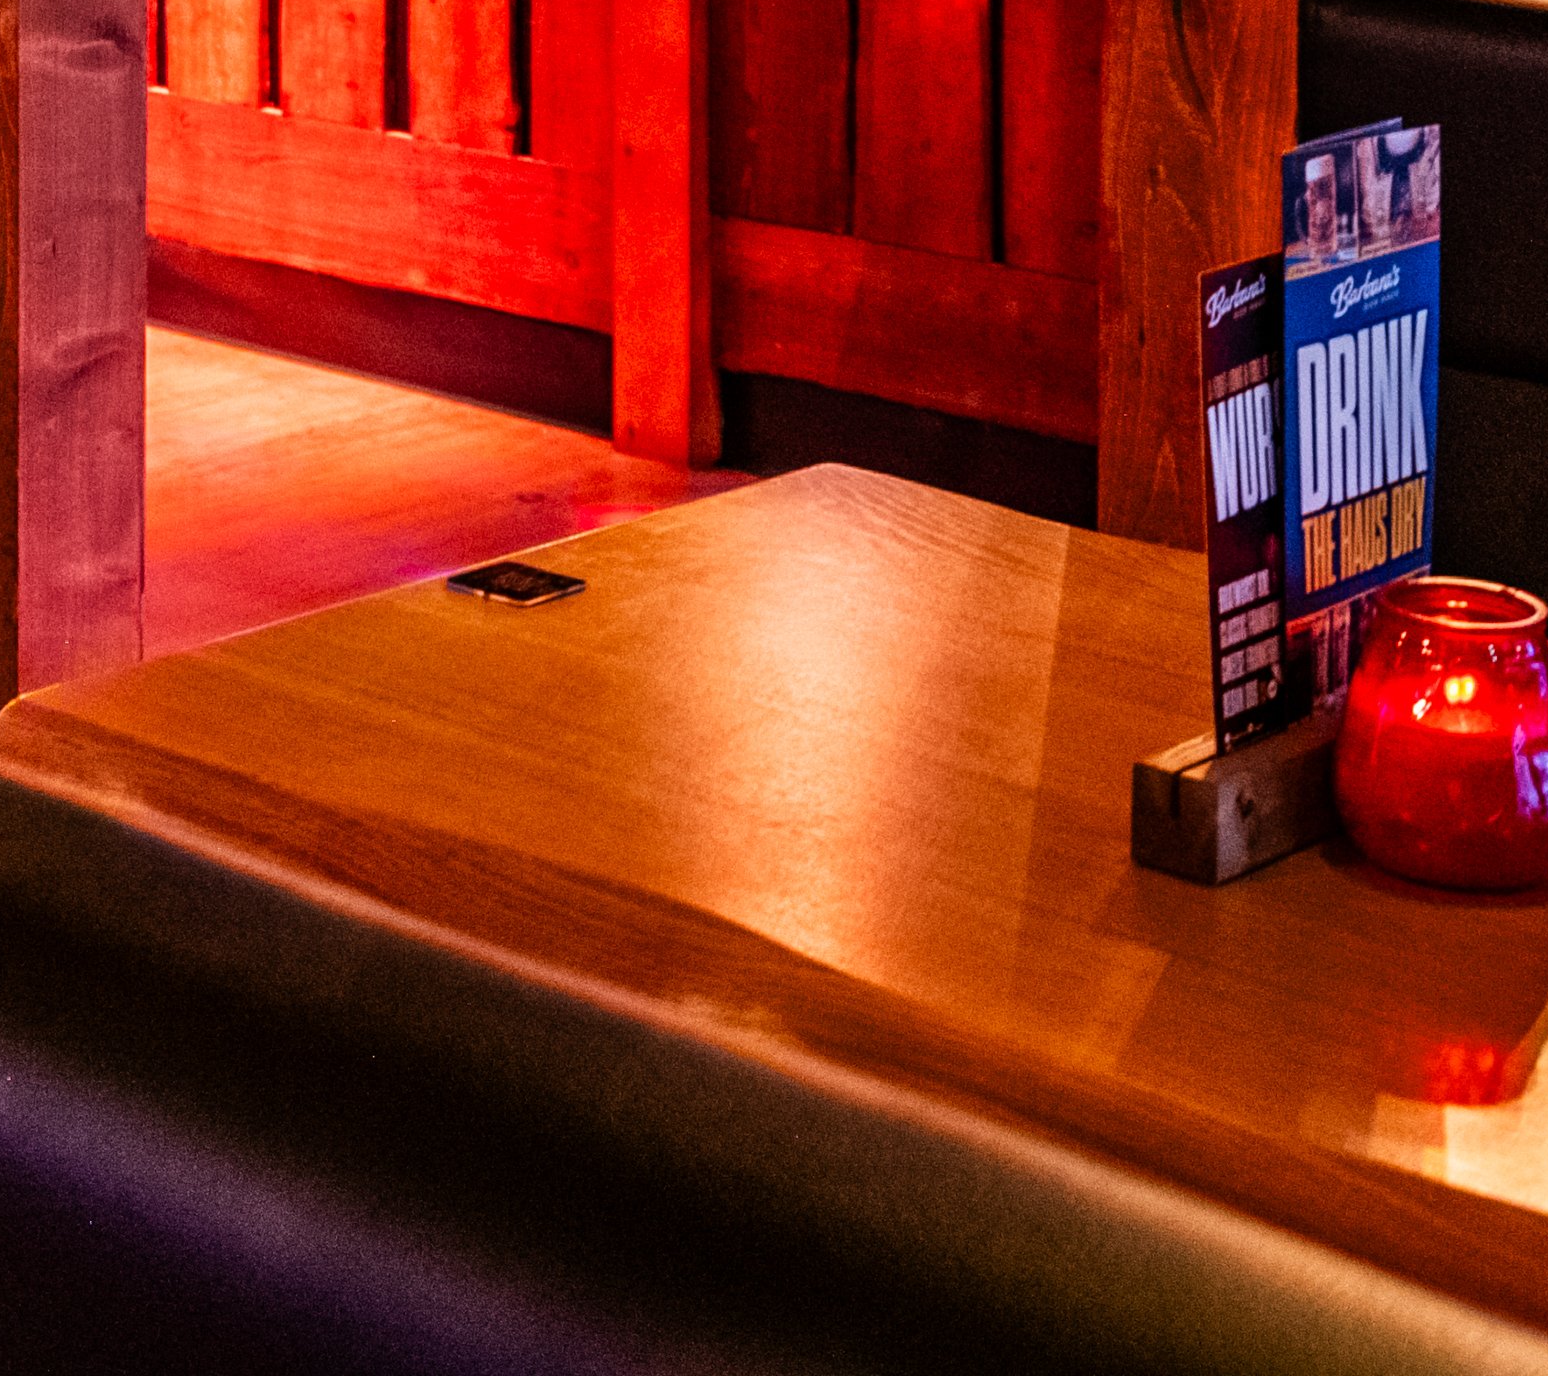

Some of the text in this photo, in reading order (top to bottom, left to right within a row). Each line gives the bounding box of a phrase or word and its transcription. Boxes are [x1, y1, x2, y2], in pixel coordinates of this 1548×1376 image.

[1207, 381, 1280, 523] WUR
[1297, 309, 1428, 517] DRINK
[1302, 510, 1337, 594] THE
[1340, 491, 1388, 582] HAUS
[1390, 476, 1427, 560] DRY
